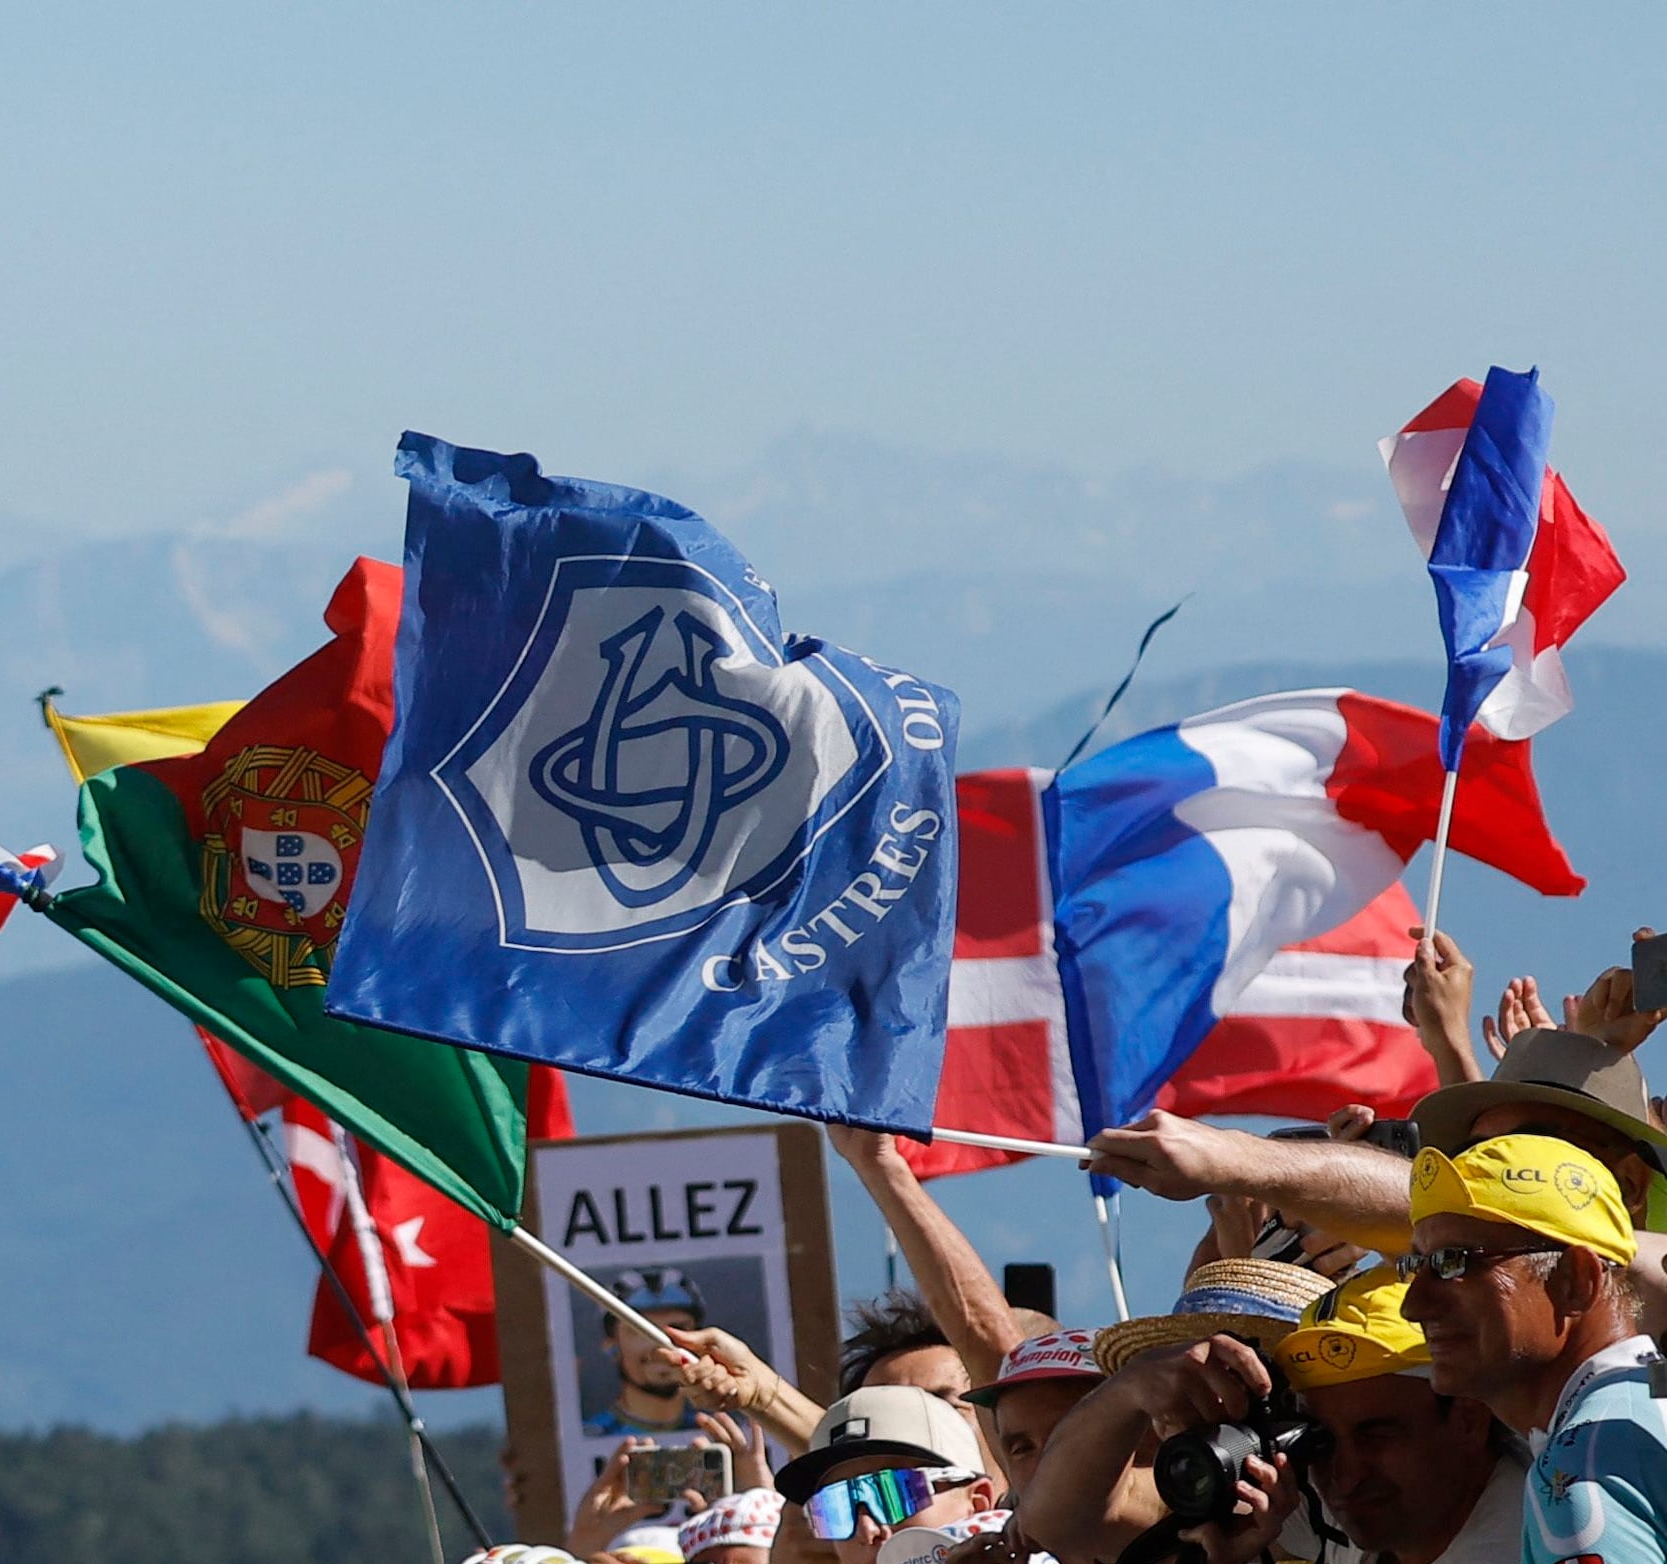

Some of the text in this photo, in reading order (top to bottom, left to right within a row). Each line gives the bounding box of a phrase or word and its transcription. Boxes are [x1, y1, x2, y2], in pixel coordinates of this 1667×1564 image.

[701, 800, 941, 993] CASTRES
[1505, 1168, 1549, 1184] LCL
[564, 1179, 764, 1247] ALLEZ
